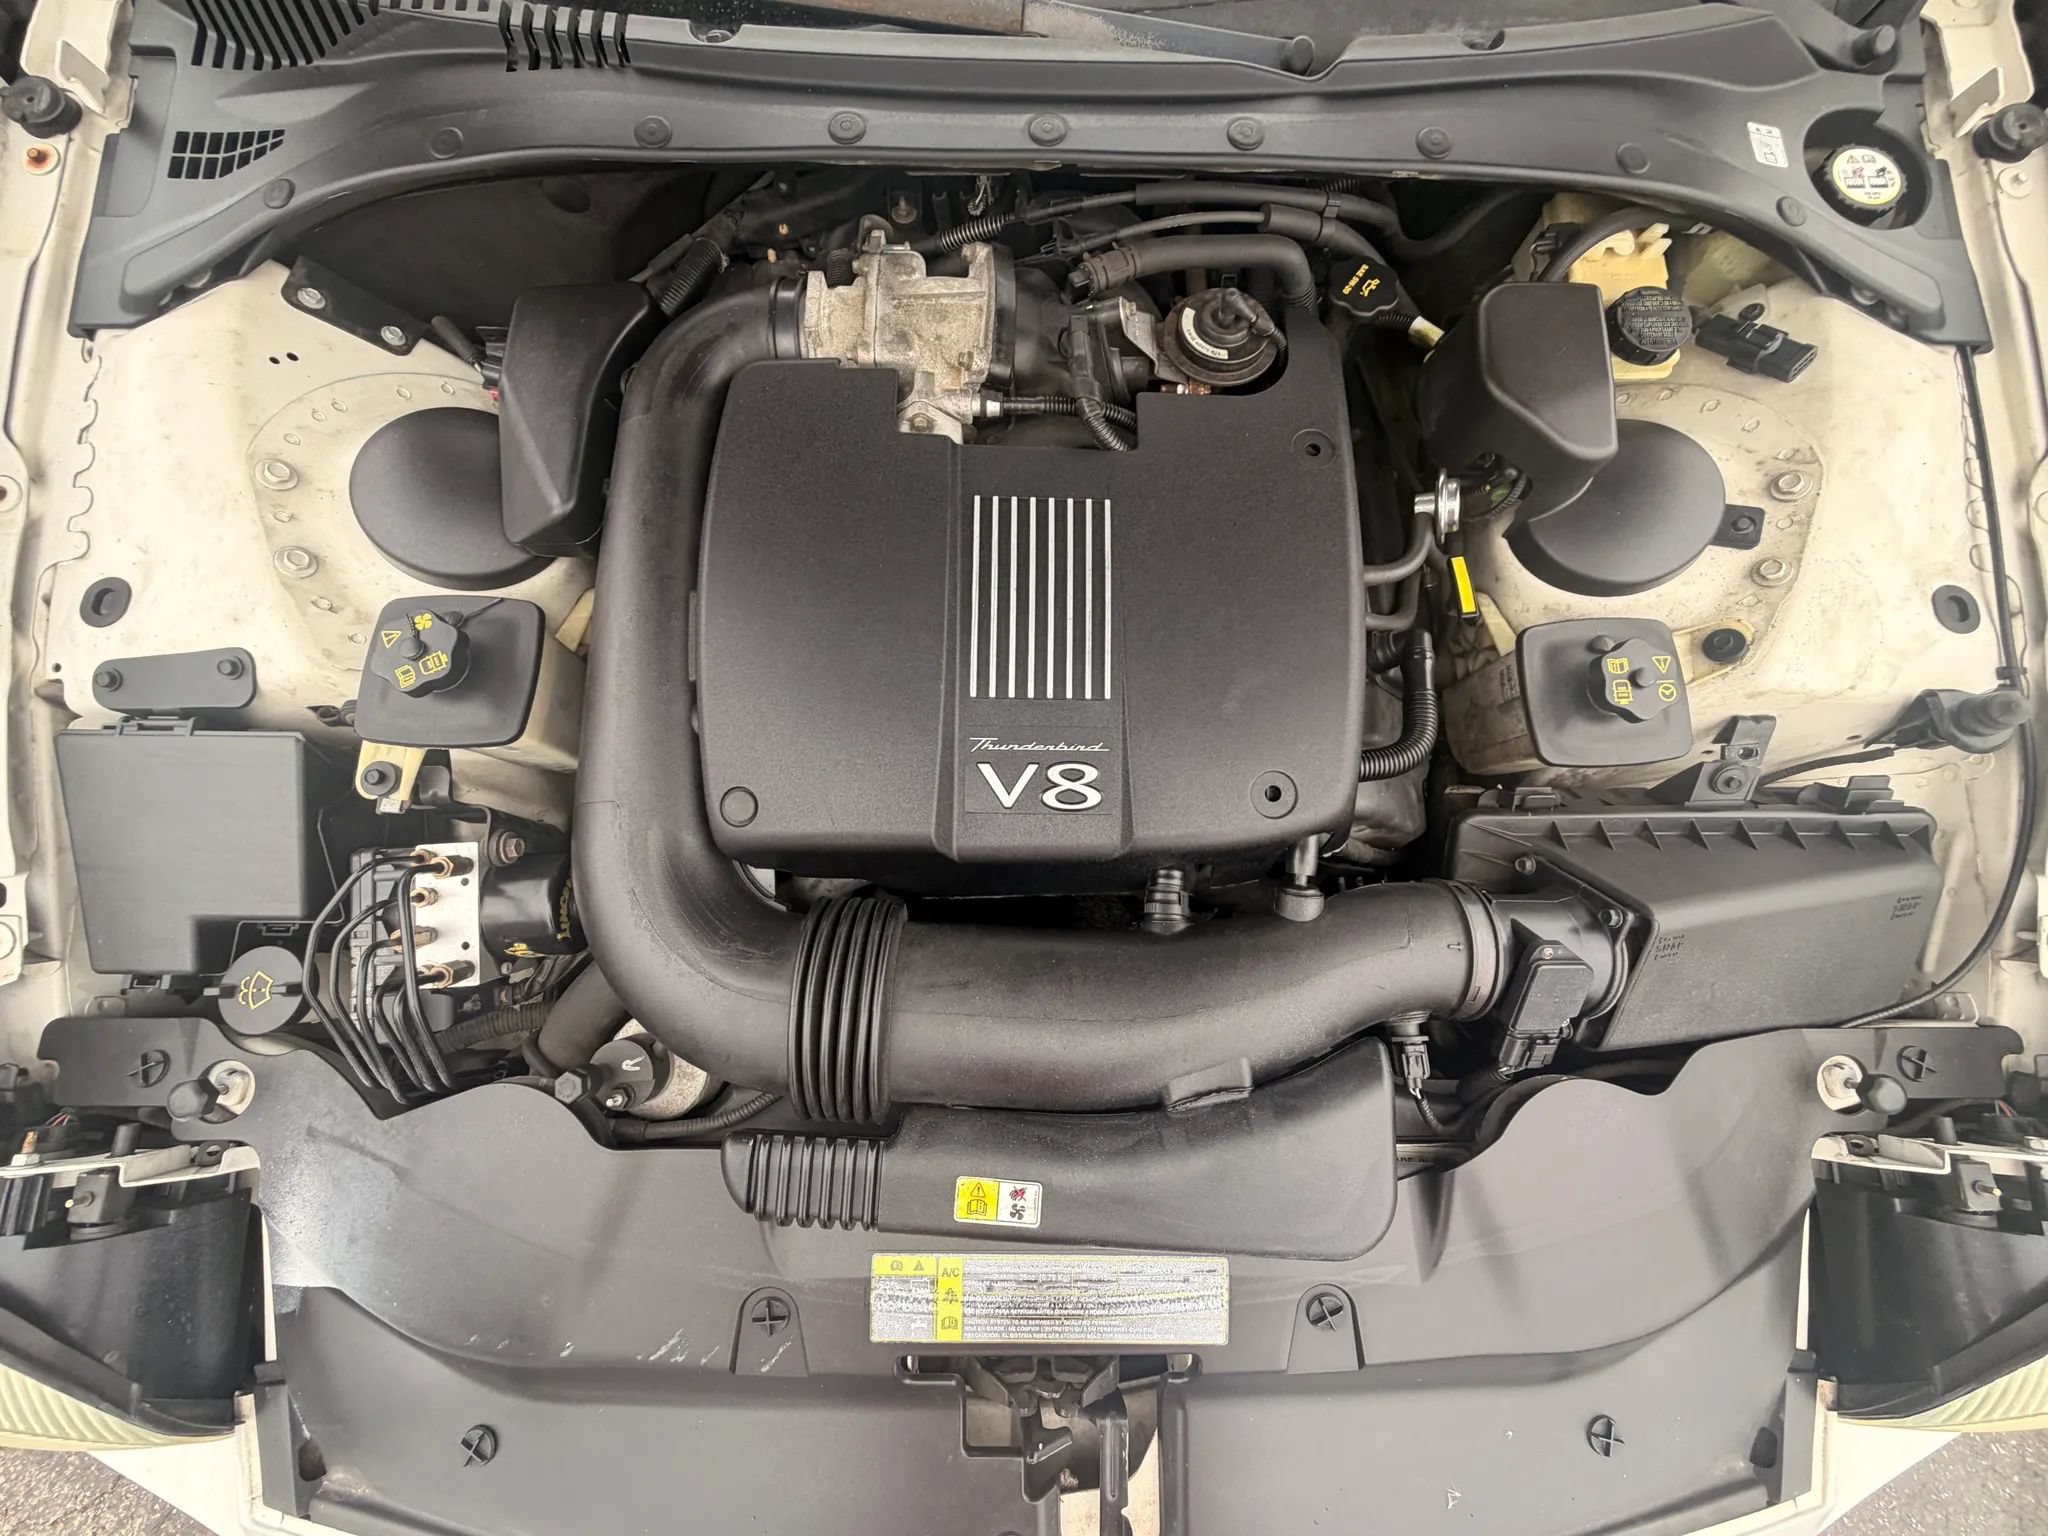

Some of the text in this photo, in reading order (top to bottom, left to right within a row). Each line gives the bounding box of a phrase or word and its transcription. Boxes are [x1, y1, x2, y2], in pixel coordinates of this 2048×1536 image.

[1356, 264, 1369, 277] SAE
[969, 737, 1110, 753] Thunderbird
[976, 761, 1102, 811] V8
[942, 1268, 960, 1278] A/C
